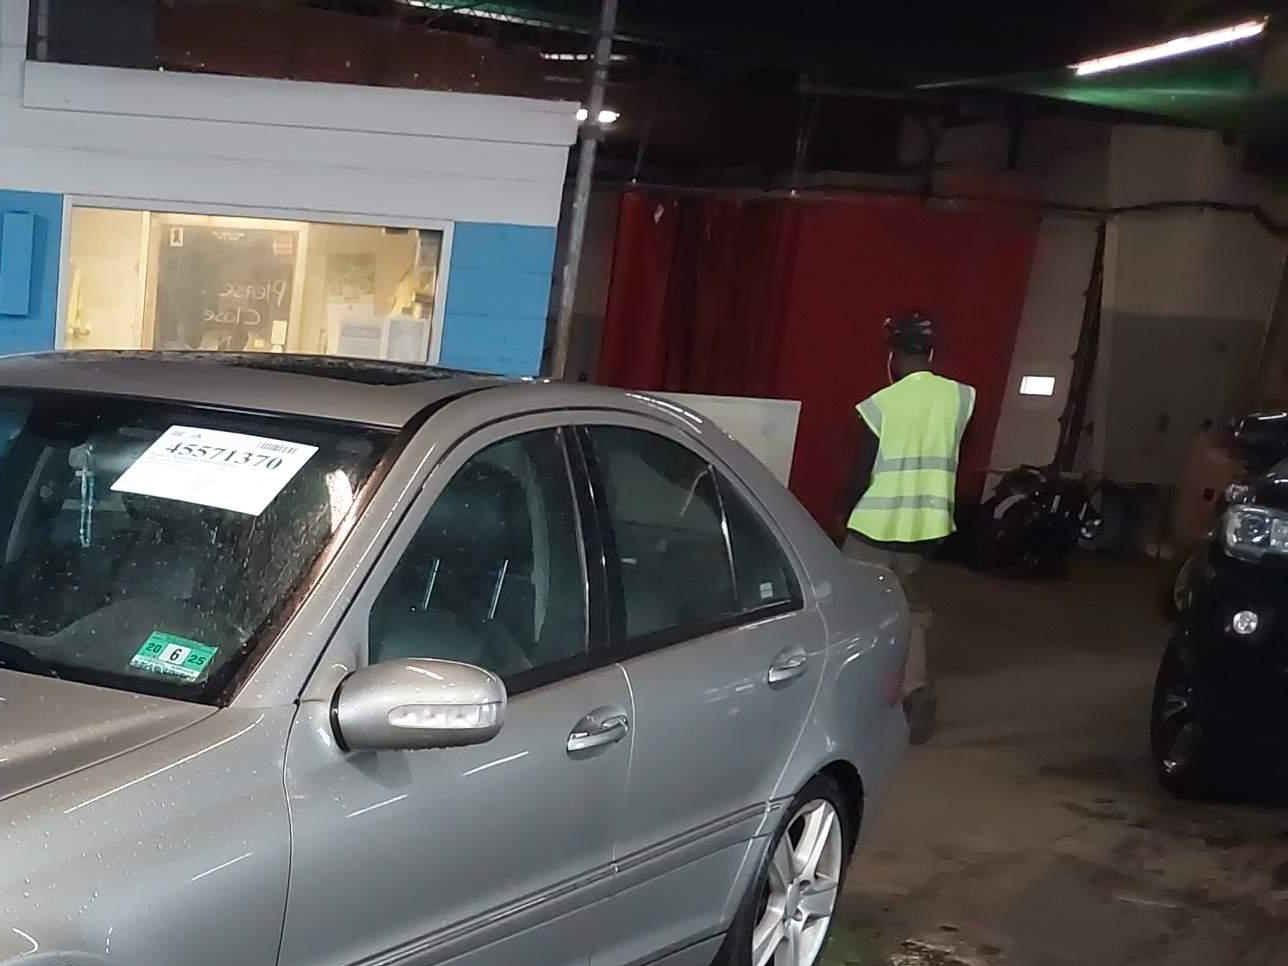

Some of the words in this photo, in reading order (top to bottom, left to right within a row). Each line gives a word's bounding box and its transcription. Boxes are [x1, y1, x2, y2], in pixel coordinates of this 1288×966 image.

[166, 442, 283, 470] 45571370
[145, 642, 162, 653] 20
[169, 648, 182, 661] 6
[187, 654, 206, 666] 25
